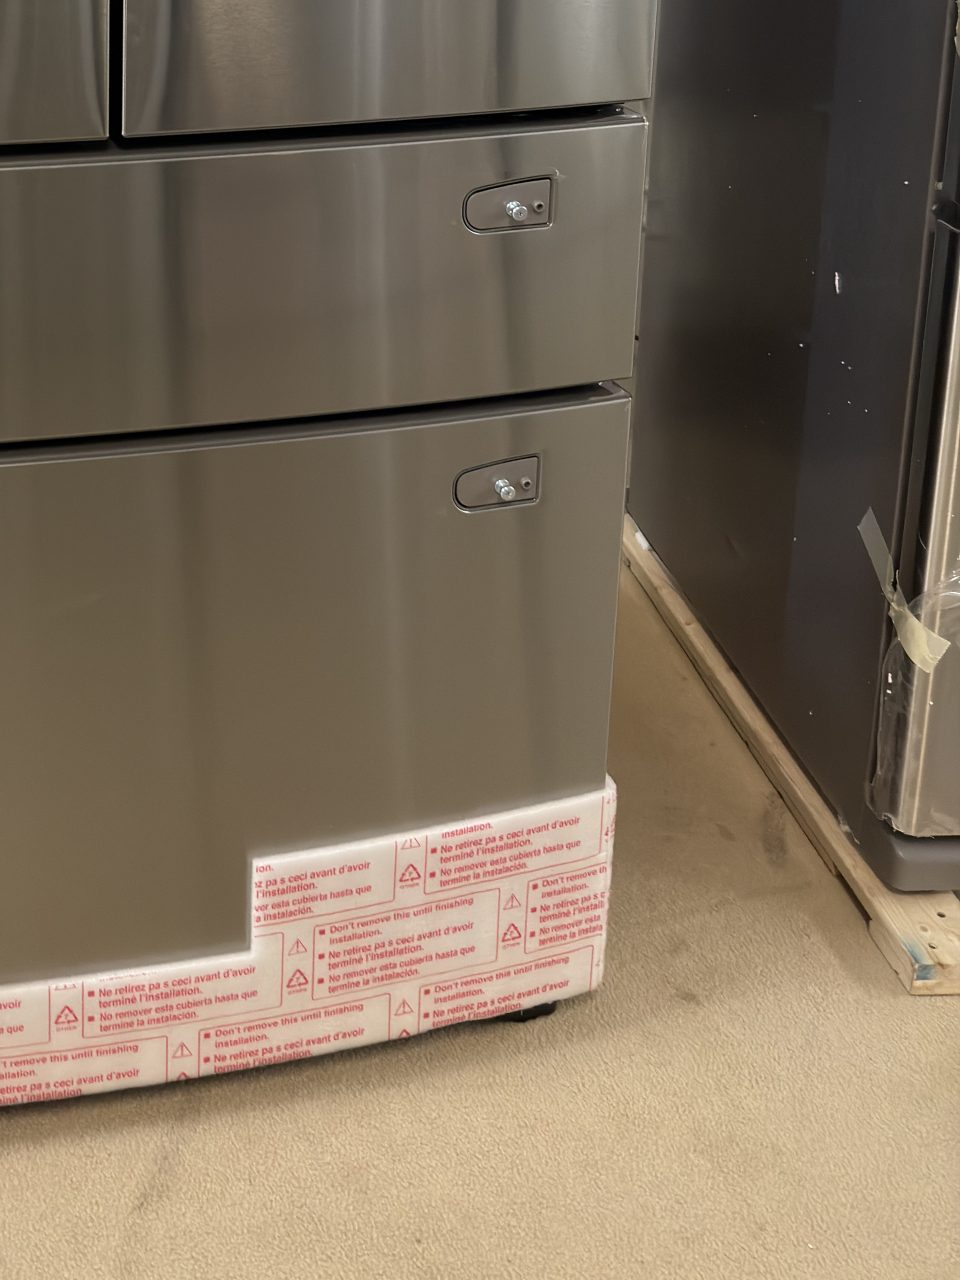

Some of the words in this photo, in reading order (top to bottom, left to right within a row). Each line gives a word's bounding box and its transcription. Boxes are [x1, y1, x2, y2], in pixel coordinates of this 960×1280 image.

[440, 844, 453, 853] Ne
[455, 838, 483, 851] retirez
[485, 836, 496, 847] pa
[506, 828, 524, 840] ceci
[526, 823, 549, 836] avant
[552, 817, 580, 830] d'avoir
[440, 849, 474, 864] terminé
[476, 839, 532, 856] l'installation.
